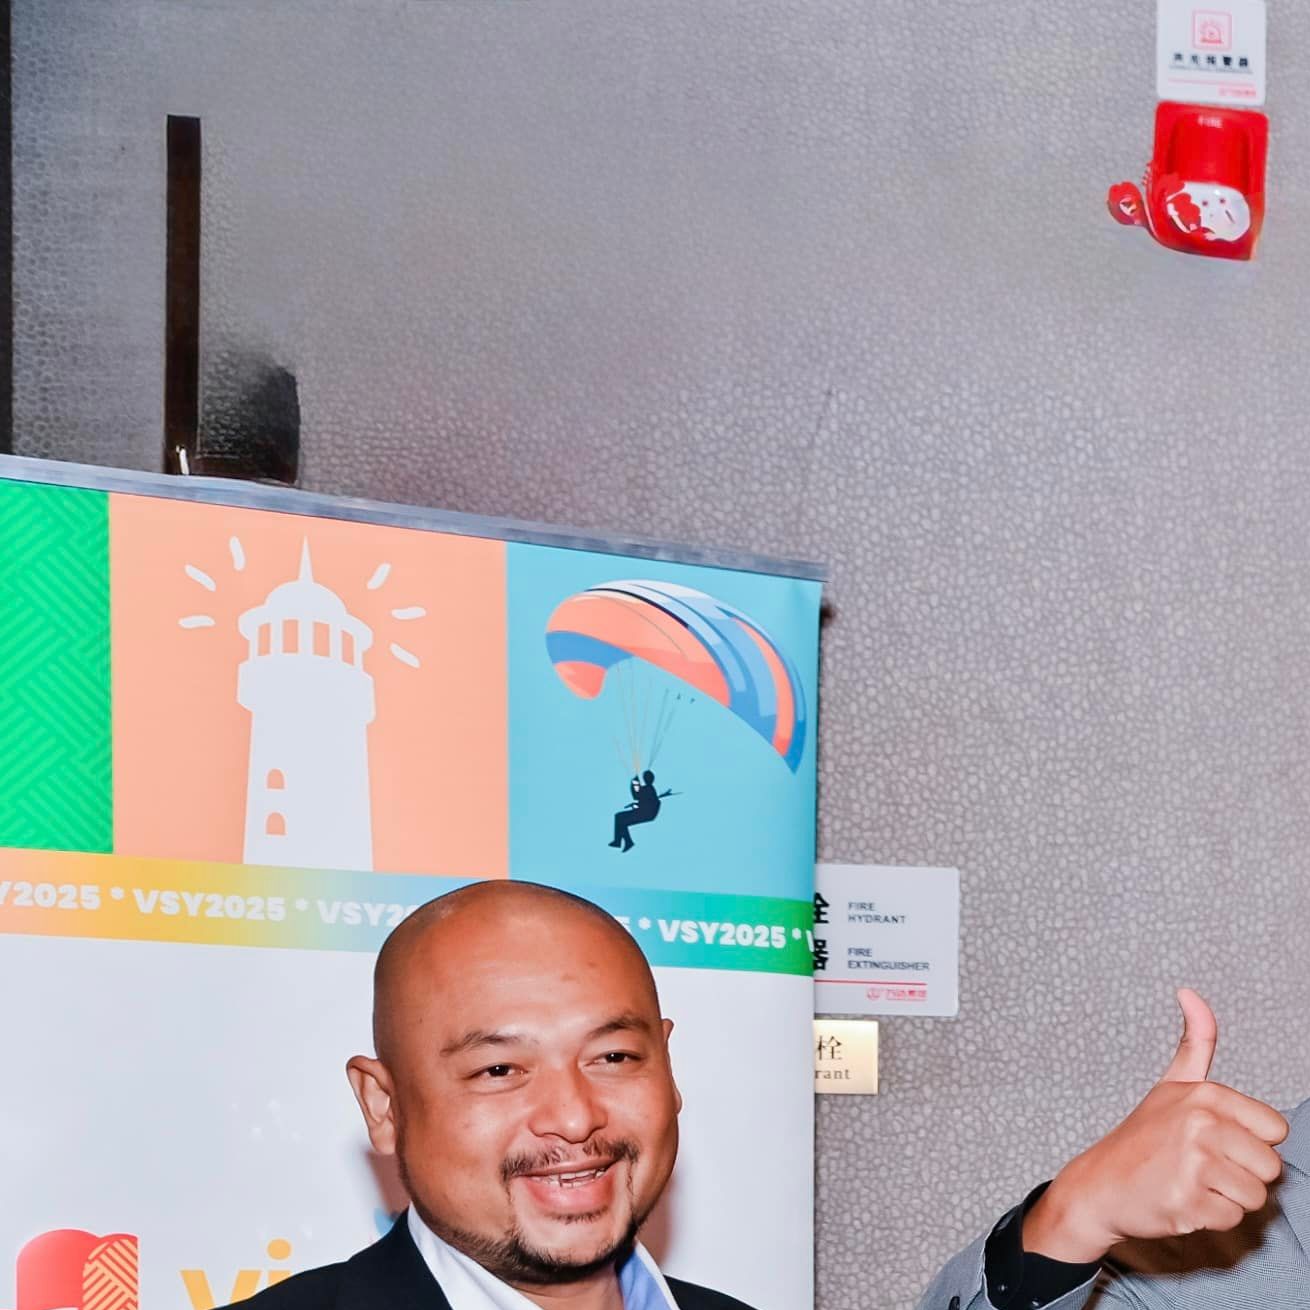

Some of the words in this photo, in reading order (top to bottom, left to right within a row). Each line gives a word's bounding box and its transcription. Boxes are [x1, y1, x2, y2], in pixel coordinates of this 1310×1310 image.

[848, 902, 875, 912] FIRE
[133, 888, 286, 922] VSY2025
[317, 899, 420, 927] VSY2
[658, 919, 787, 949] VSY2025
[848, 915, 906, 925] HYDRANT
[848, 948, 873, 958] FIRE
[848, 960, 929, 971] EXTINGUISHER
[817, 1034, 843, 1061] 栓
[815, 1068, 851, 1080] rant
